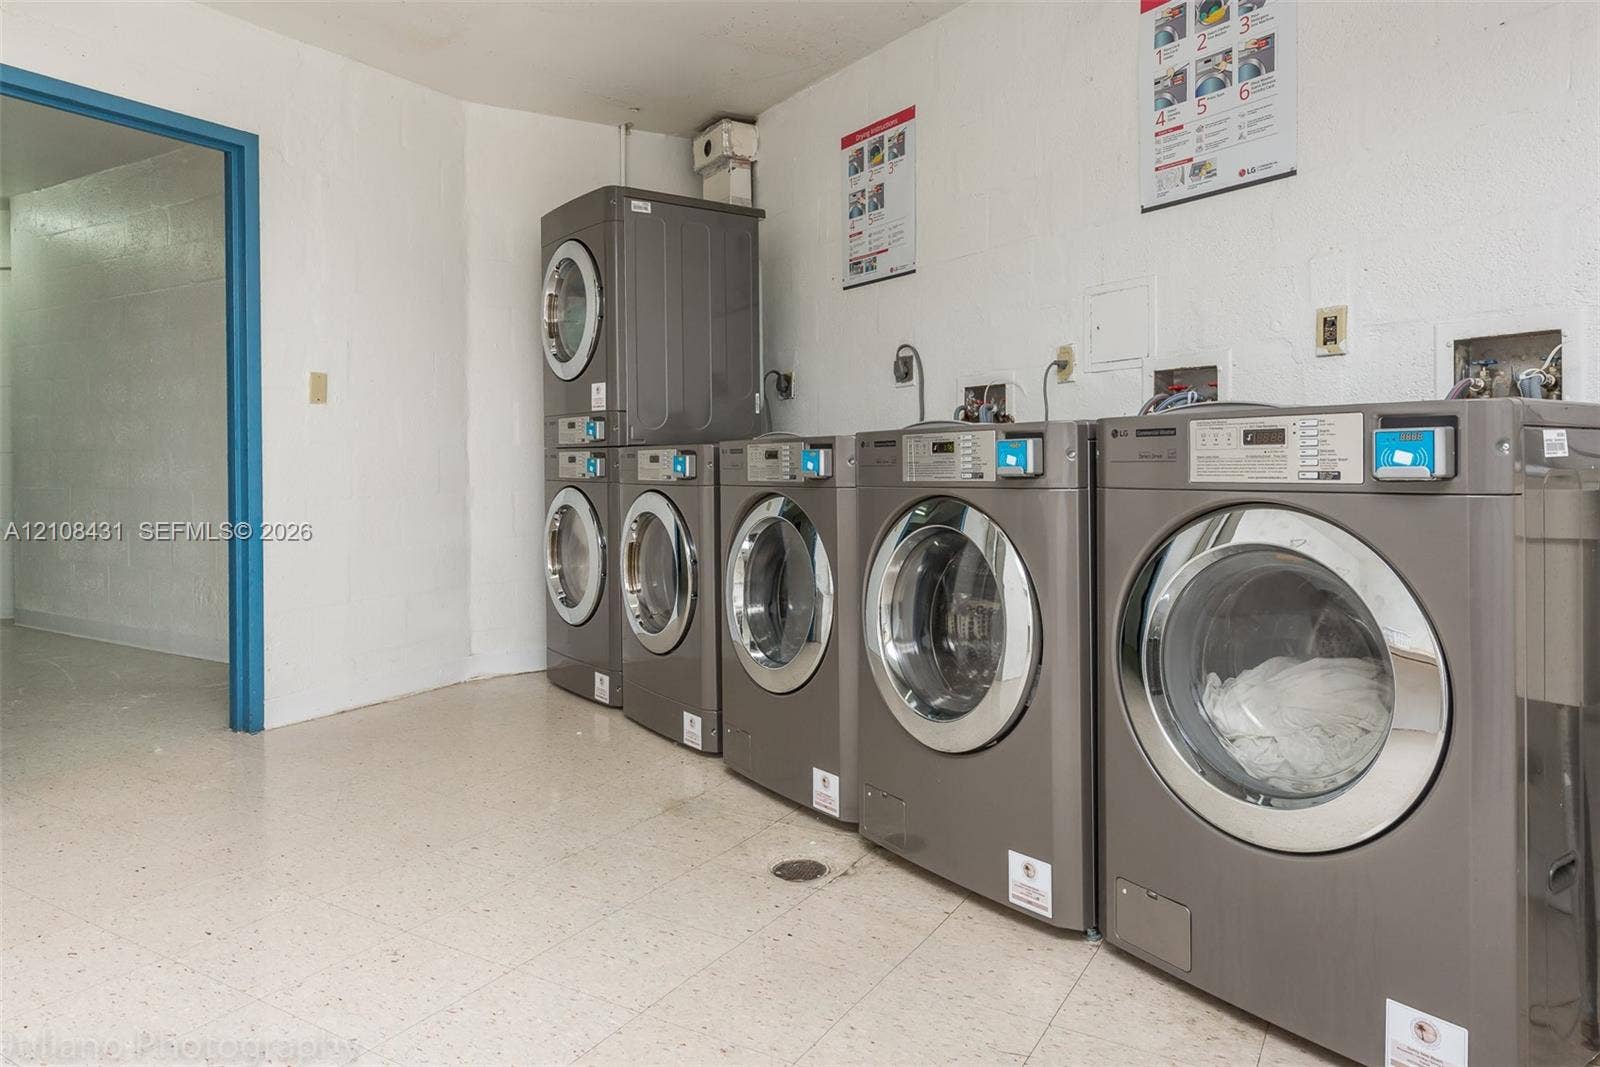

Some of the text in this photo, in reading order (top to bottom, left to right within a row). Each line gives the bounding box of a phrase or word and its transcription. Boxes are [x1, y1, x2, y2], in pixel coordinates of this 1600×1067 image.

[1240, 16, 1250, 35] 3
[1197, 32, 1207, 51] 2
[1155, 49, 1162, 65] 1
[1239, 82, 1250, 100] 6
[1197, 97, 1207, 115] 5
[1155, 110, 1166, 126] 4
[855, 130, 870, 142] Drying
[887, 161, 895, 175] 3
[1246, 166, 1257, 175] LG
[868, 169, 874, 182] 2
[849, 177, 854, 189] 1
[868, 213, 874, 226] 5
[1119, 430, 1129, 438] LG
